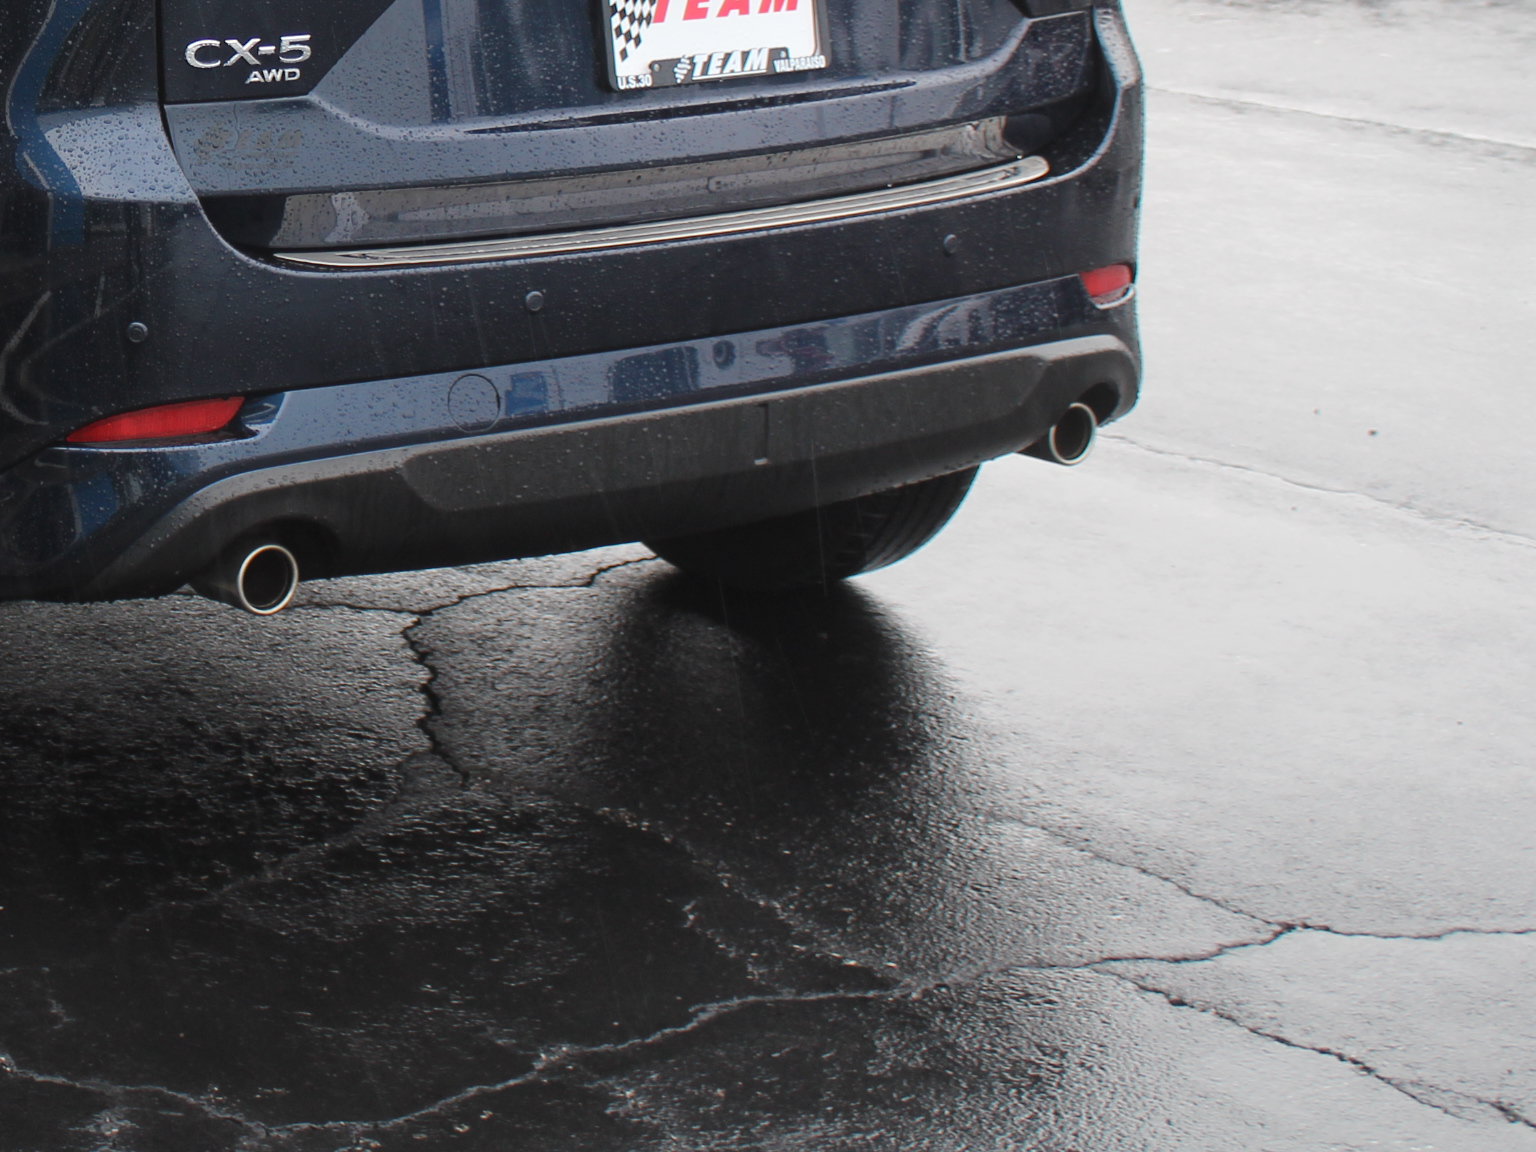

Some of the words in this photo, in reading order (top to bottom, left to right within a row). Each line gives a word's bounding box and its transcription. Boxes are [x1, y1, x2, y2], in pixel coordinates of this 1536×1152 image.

[185, 34, 312, 68] CX-5
[692, 48, 770, 78] TEAM
[245, 68, 301, 84] AWD
